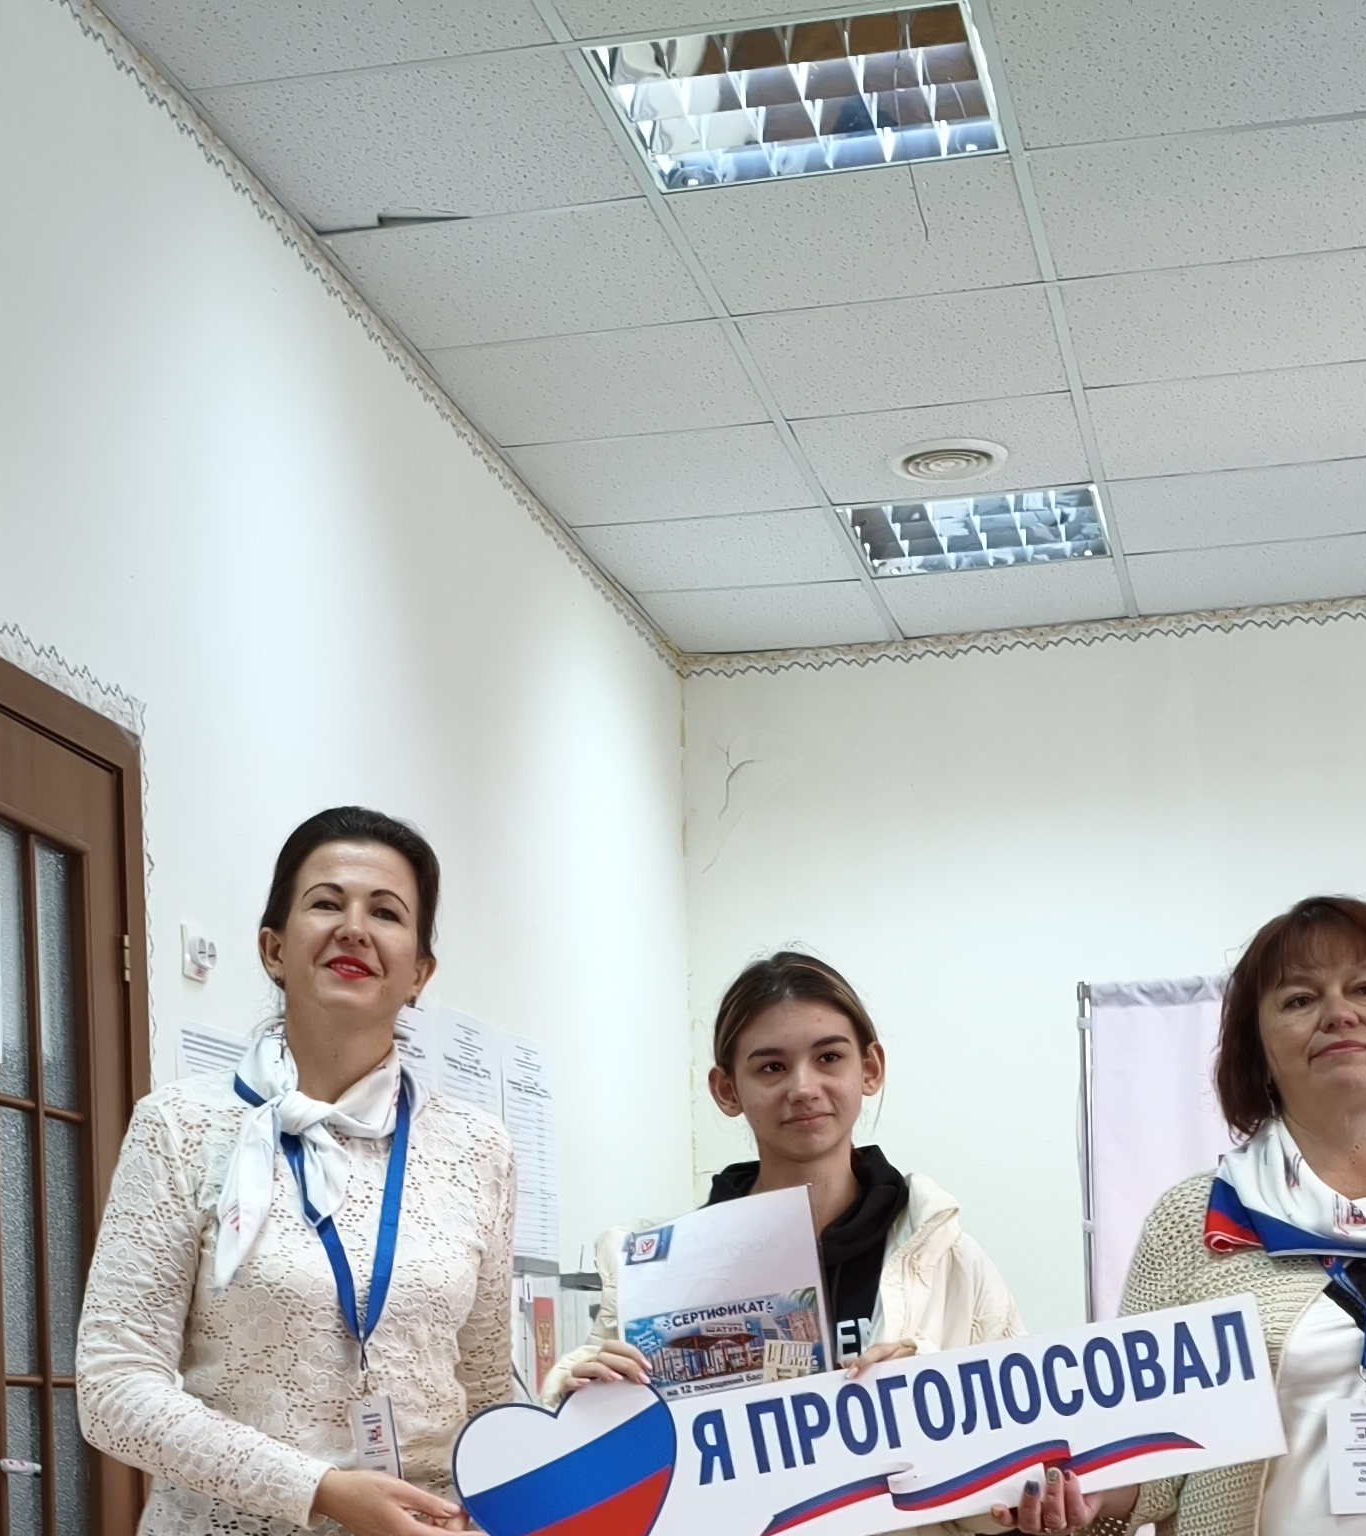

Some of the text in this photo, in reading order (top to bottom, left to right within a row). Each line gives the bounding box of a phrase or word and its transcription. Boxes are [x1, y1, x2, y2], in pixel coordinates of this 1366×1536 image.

[672, 1300, 764, 1327] СЕРТИФИКАТ
[680, 1385, 692, 1394] 12
[692, 1312, 1256, 1486] Я ПРОГОЛОСОВАЛ
